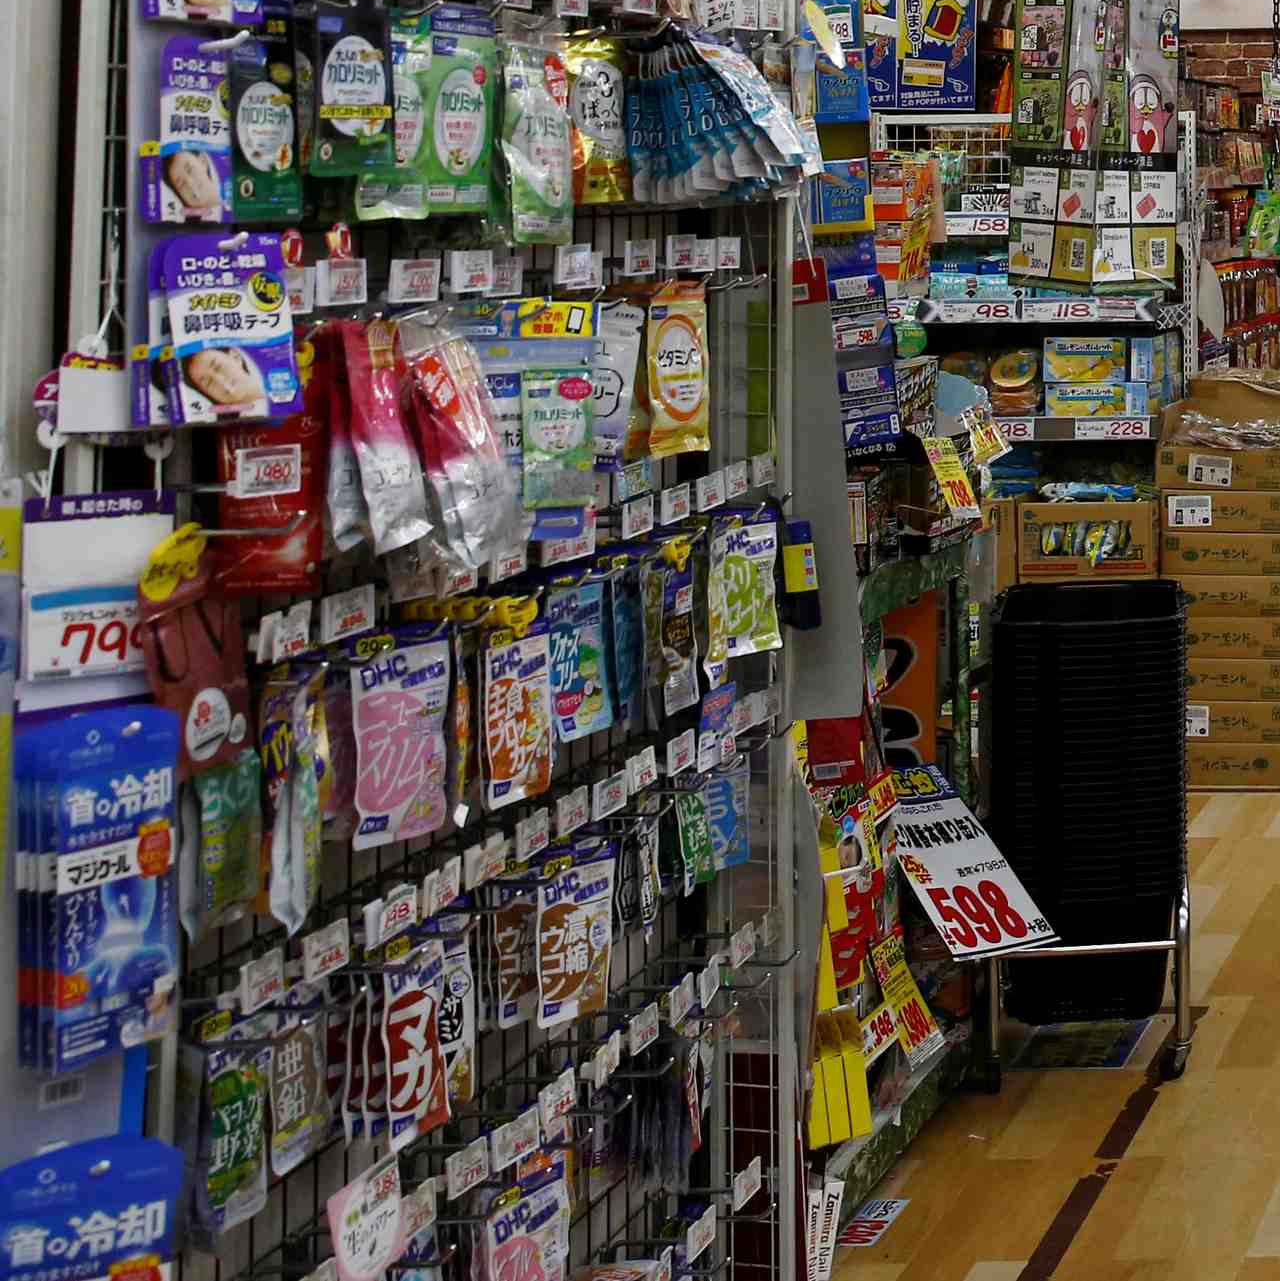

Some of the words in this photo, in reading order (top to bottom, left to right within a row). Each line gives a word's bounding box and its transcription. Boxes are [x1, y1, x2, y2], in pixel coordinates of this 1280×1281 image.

[327, 63, 383, 86] カロリミット
[361, 654, 408, 690] DHC
[490, 646, 523, 679] DHC
[66, 766, 174, 828] 首の冷却
[543, 870, 580, 905] DHC
[388, 994, 434, 1108] マカ
[495, 1201, 531, 1238] DHC
